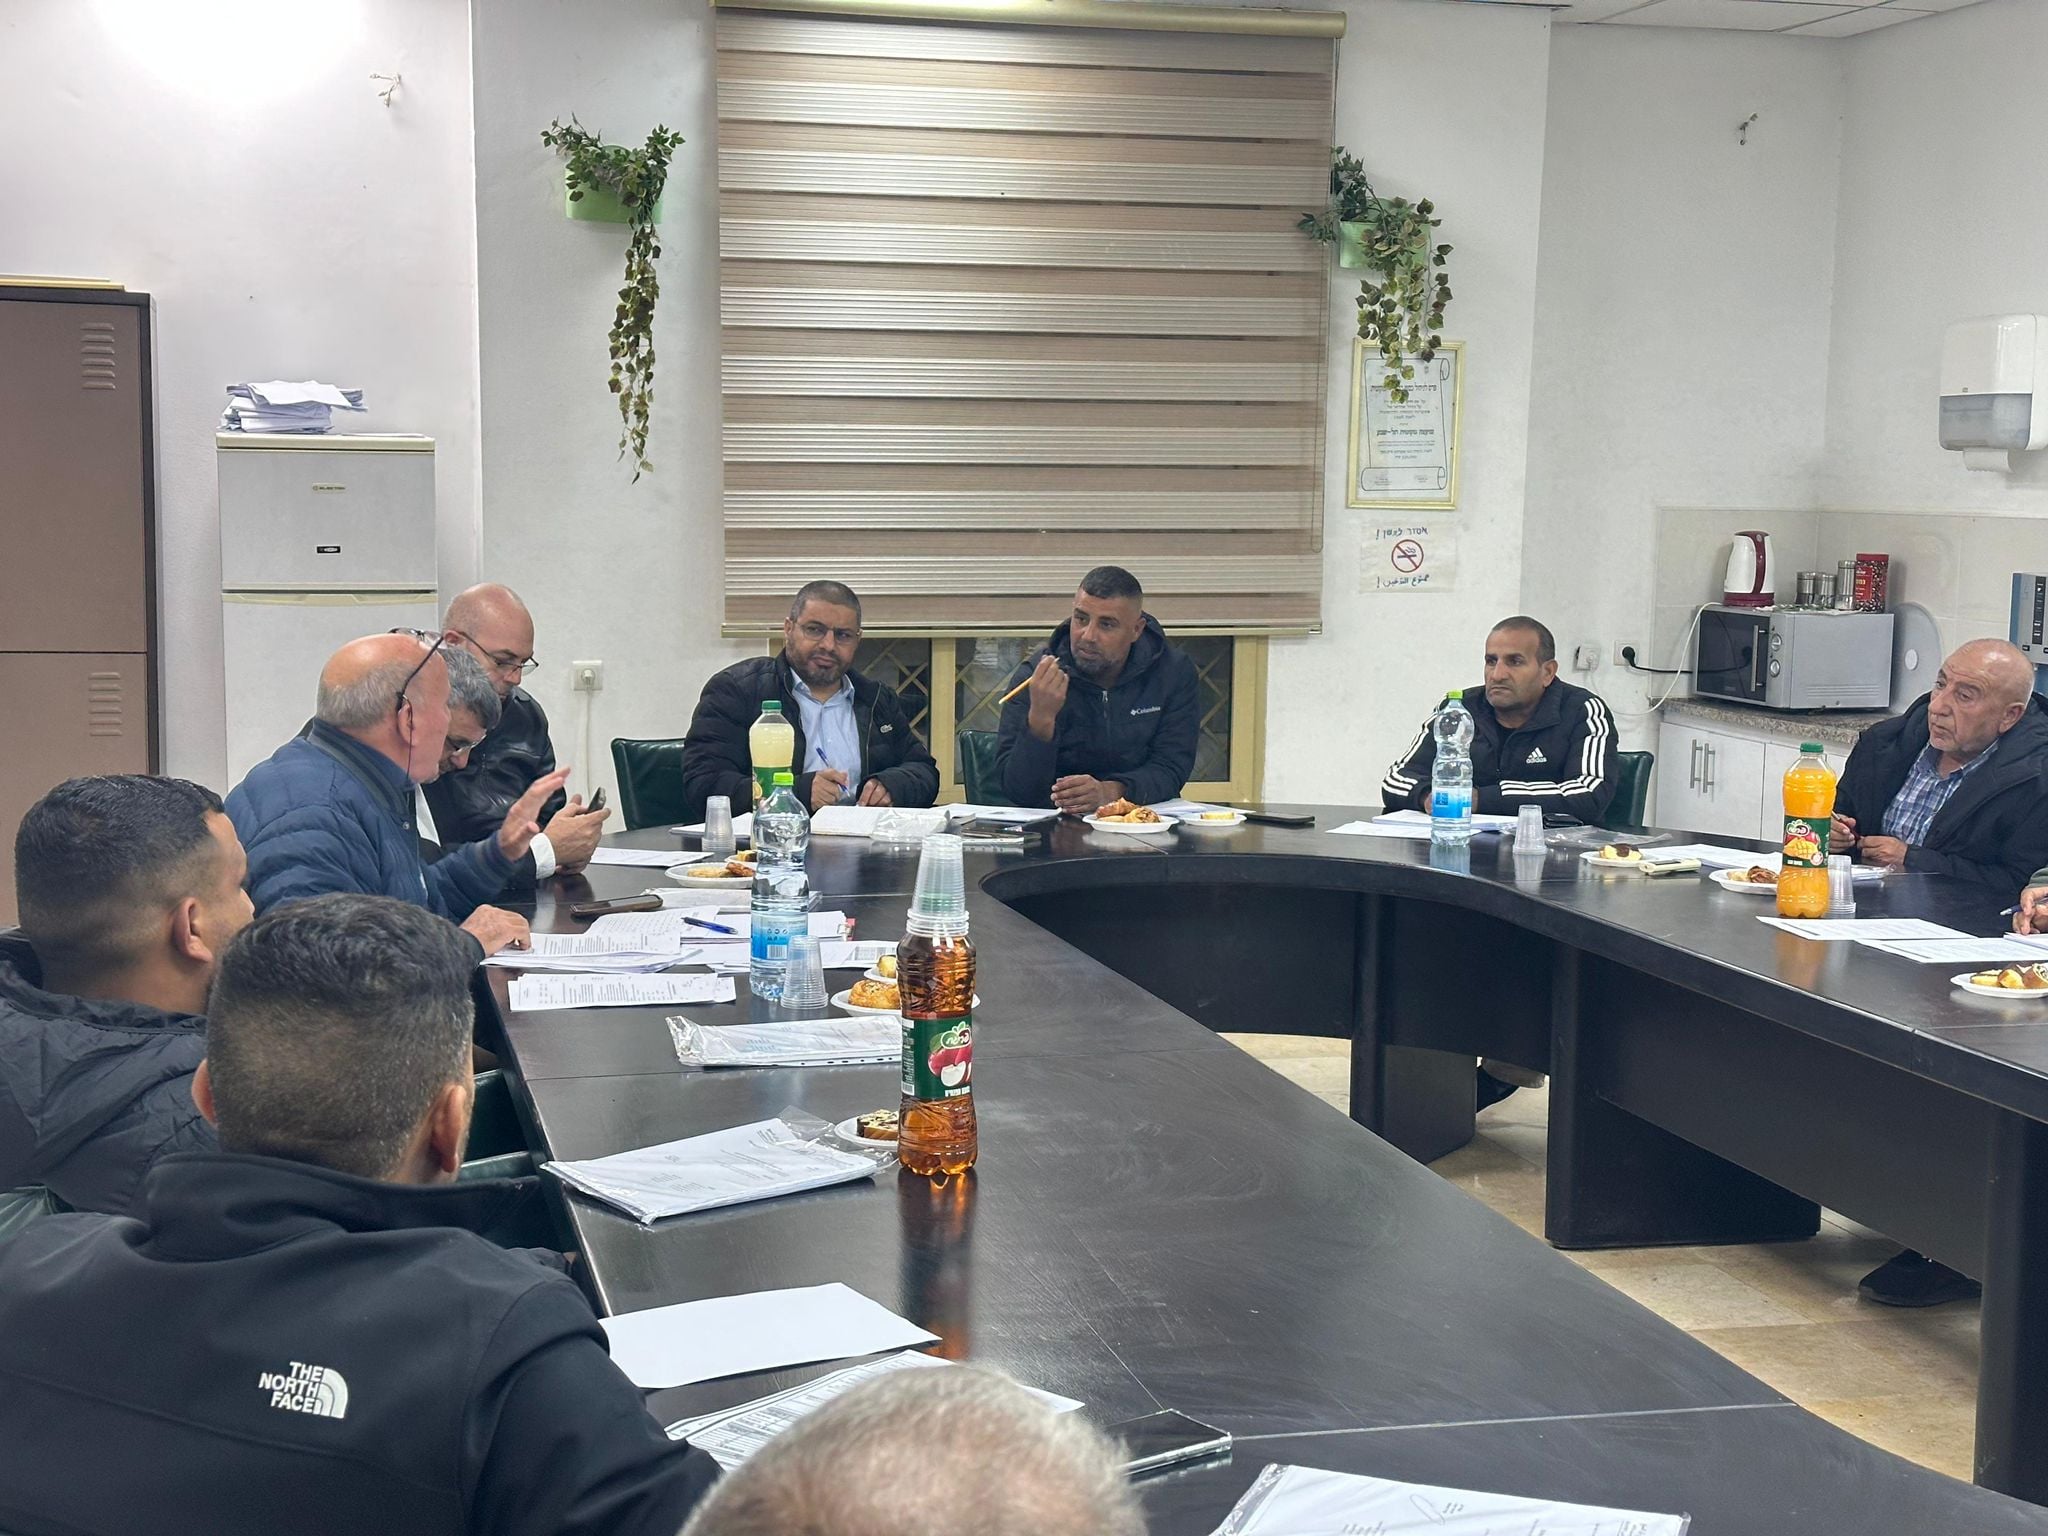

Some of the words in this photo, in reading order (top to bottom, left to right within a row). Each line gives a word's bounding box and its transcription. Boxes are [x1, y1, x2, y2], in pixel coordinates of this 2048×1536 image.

[1406, 526, 1429, 536] אסור
[289, 1361, 324, 1382] THE
[258, 1372, 320, 1398] NORTH
[270, 1391, 315, 1413] FACE
